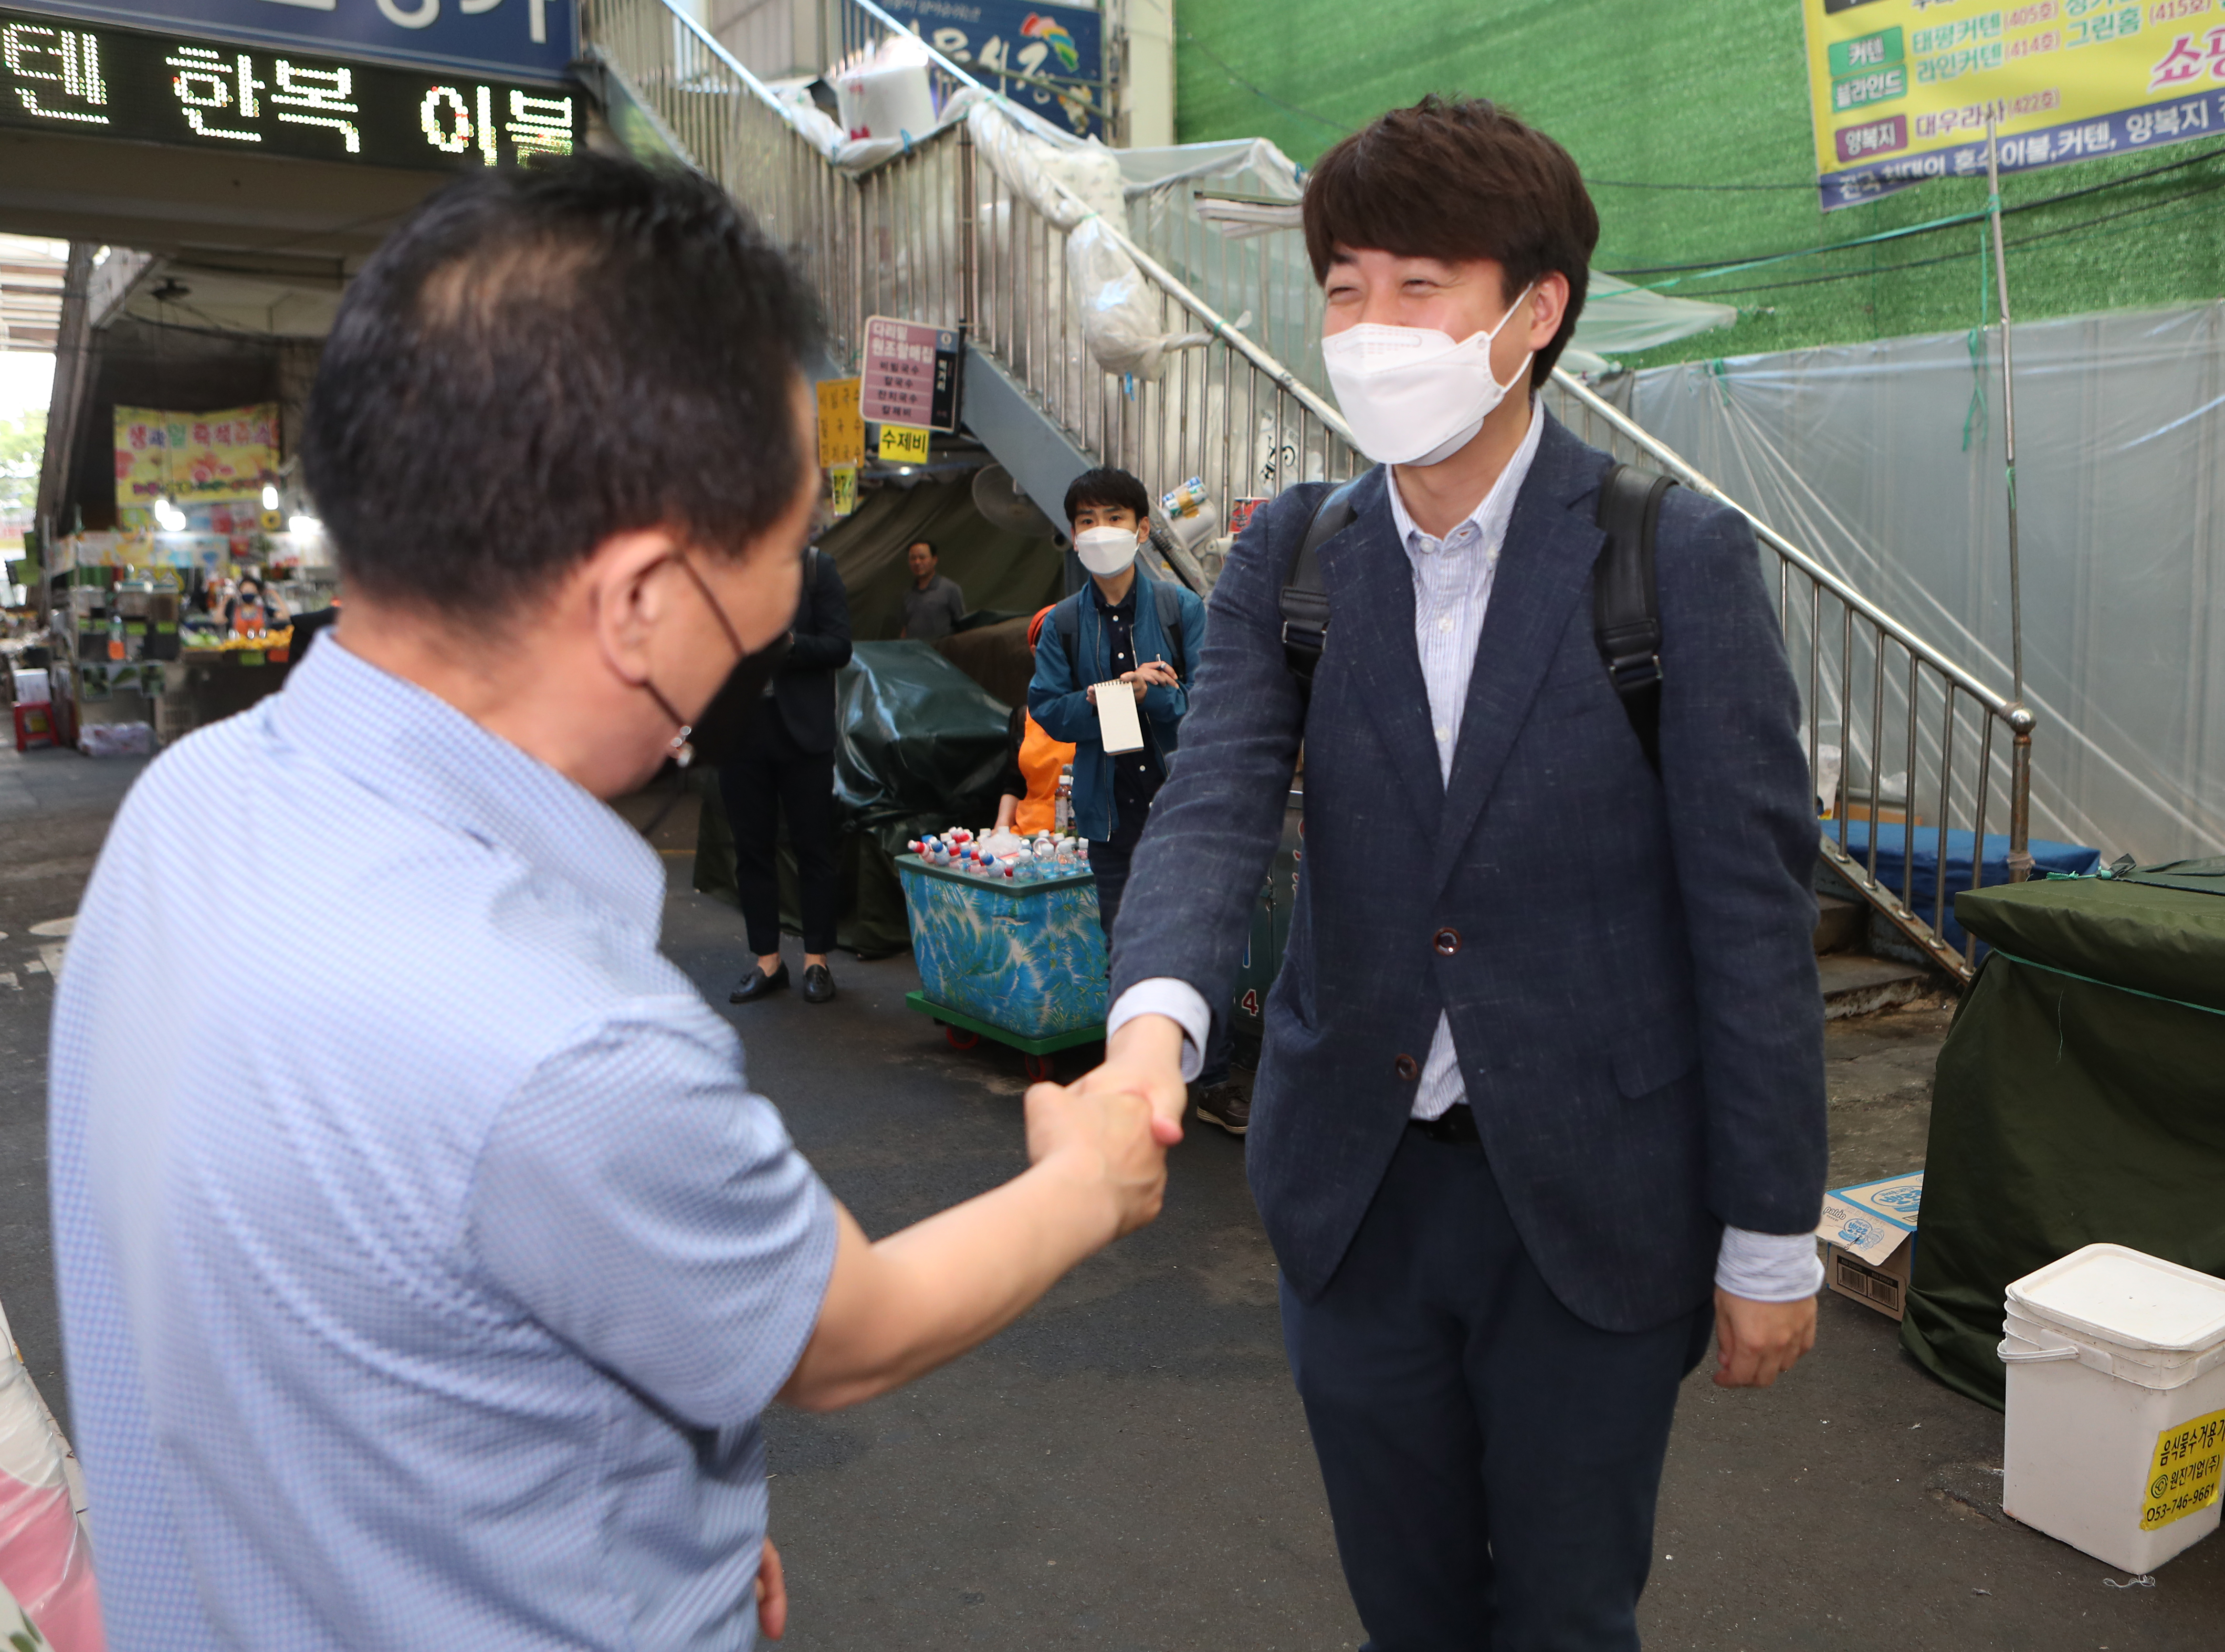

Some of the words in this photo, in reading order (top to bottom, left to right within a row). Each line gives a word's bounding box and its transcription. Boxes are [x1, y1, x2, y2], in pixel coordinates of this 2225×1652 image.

[2067, 6, 2141, 49] 그린홈
[1848, 36, 1885, 66] 커텐
[1916, 42, 2003, 84] 라인커텐
[165, 46, 361, 154] 한복
[1845, 122, 1897, 157] 양복지
[2125, 99, 2210, 144] 양복지
[882, 429, 927, 454] 수제비
[1241, 988, 1259, 1016] 4
[1823, 1206, 1847, 1220] paldo
[2161, 1419, 2225, 1466] 음식물수거용기
[2170, 1454, 2219, 1490] 원진기업(주)
